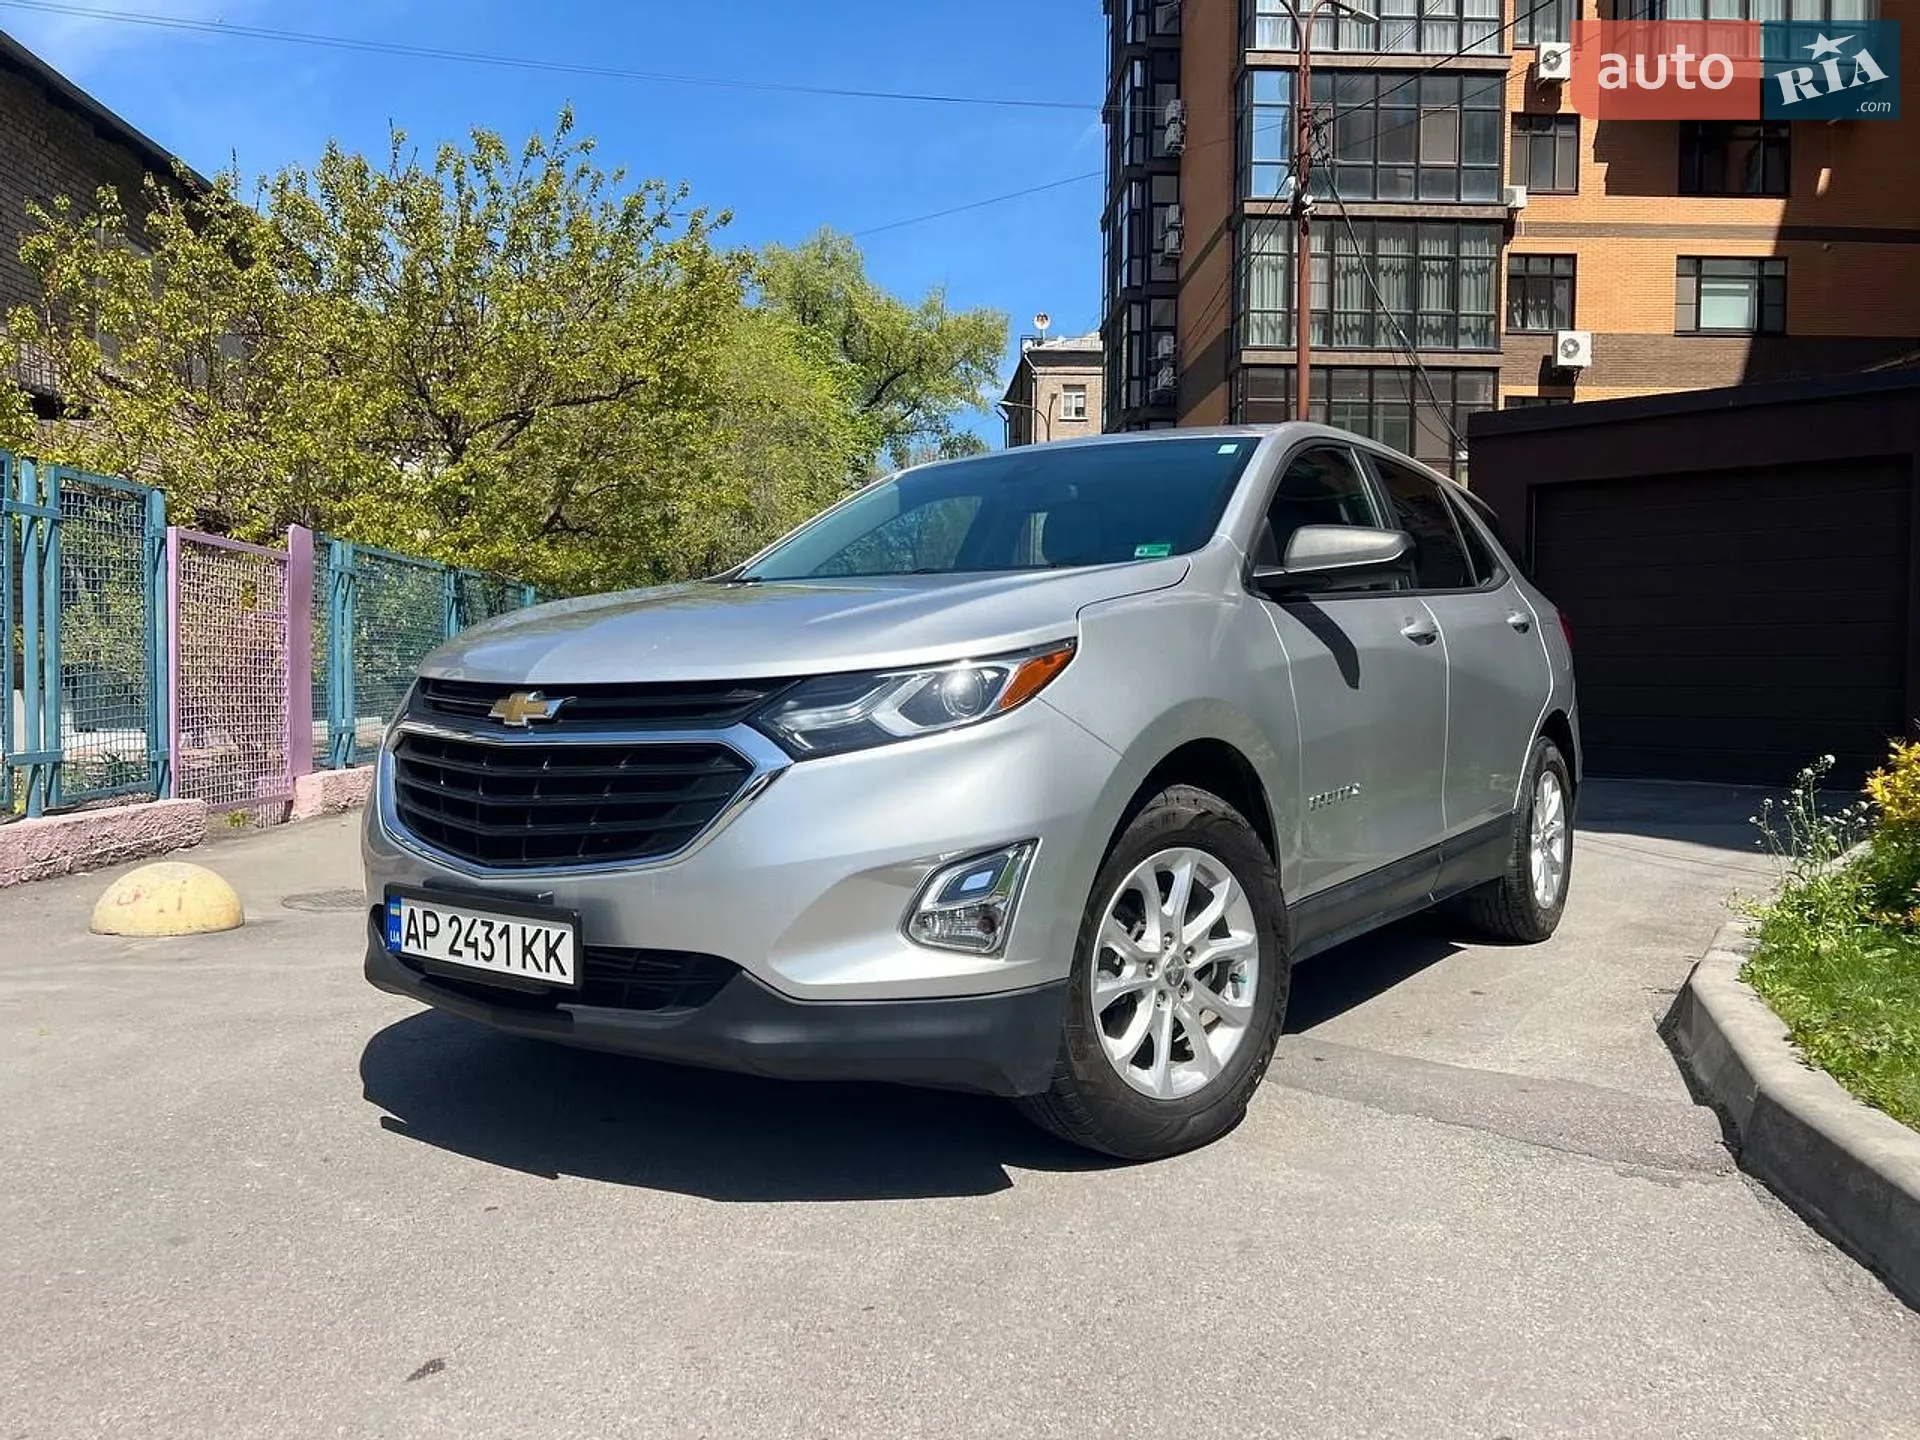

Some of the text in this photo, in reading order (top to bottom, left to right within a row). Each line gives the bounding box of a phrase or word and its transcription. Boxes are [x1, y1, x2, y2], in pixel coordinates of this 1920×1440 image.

[389, 929, 401, 943] UA
[404, 907, 567, 976] AP 2431 KK
